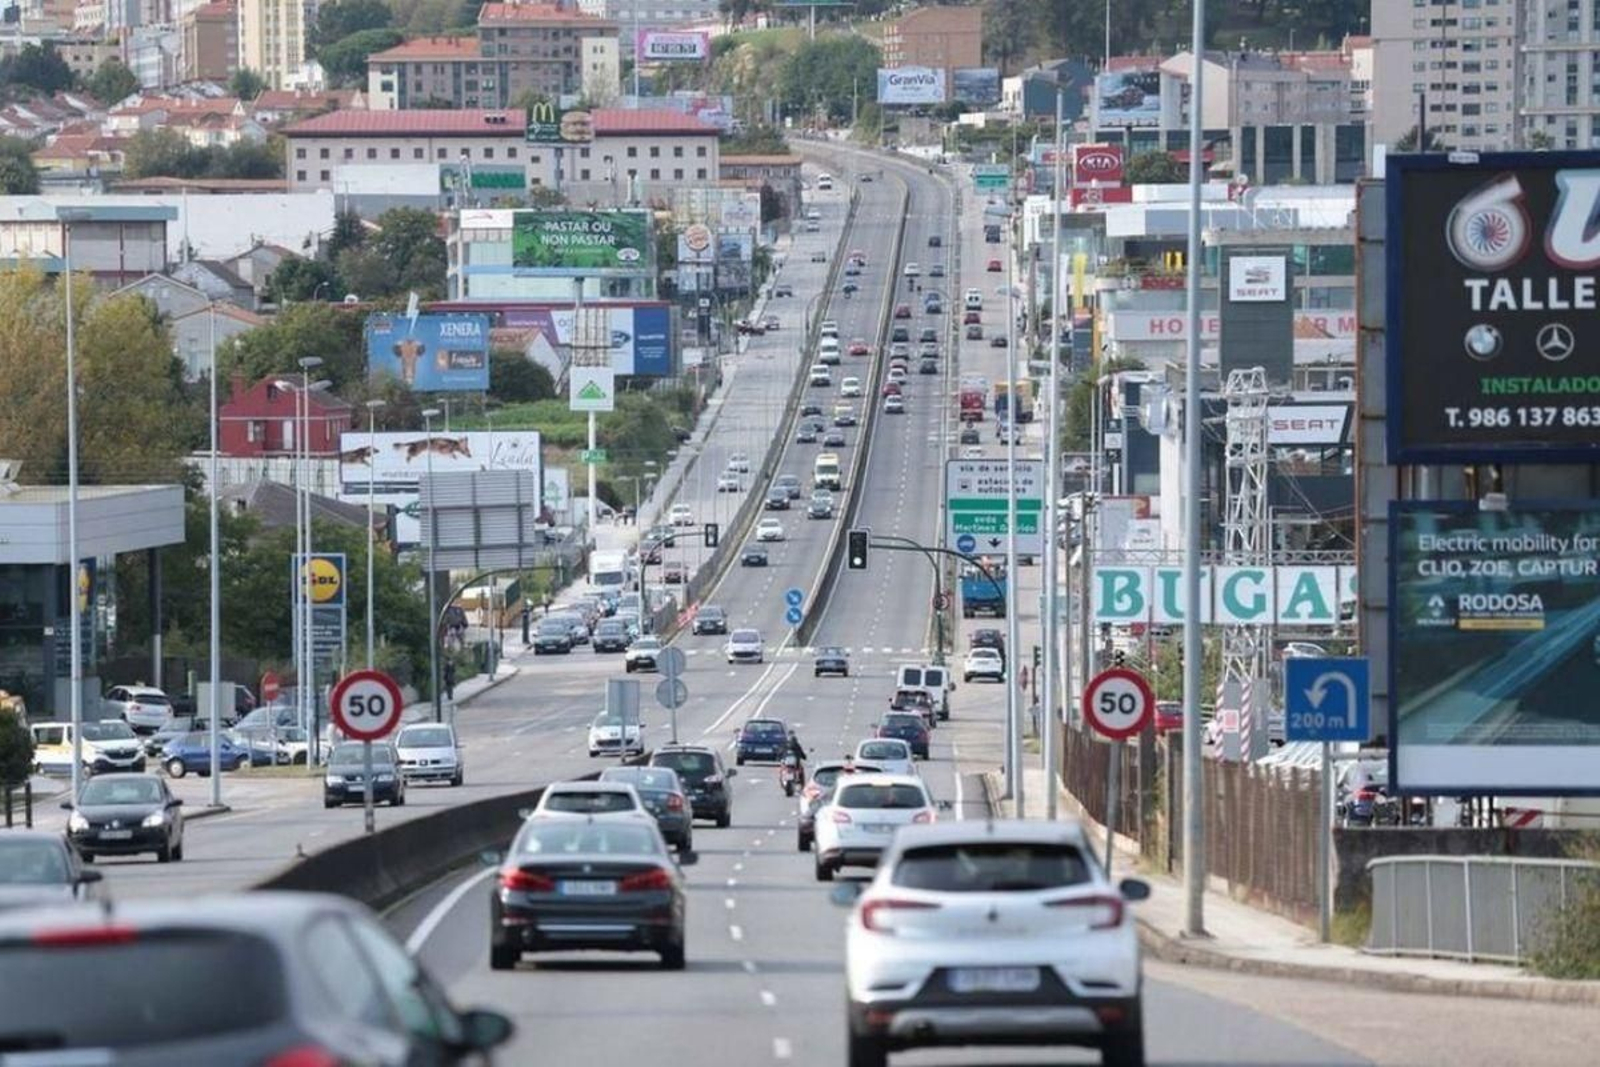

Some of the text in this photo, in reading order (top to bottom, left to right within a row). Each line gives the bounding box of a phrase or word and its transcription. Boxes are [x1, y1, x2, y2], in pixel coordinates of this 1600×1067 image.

[545, 222, 612, 232] PASTAR OU
[541, 235, 615, 245] NON PASTAR
[1236, 288, 1278, 297] SEAT
[440, 322, 481, 337] XENERA
[1151, 318, 1220, 334] HOE
[1273, 419, 1339, 431] SEAT
[1444, 407, 1600, 427] T. 986 137 863
[994, 464, 1033, 473] sericio
[1418, 533, 1599, 554] Electric mobility for
[1418, 559, 1598, 579] CLIO, ZOE, CAPTUR
[1096, 570, 1357, 620] BUGA
[1458, 594, 1544, 611] RODOSA
[349, 695, 386, 717] 50
[1100, 691, 1137, 715] 50
[1291, 712, 1345, 729] 200 m
